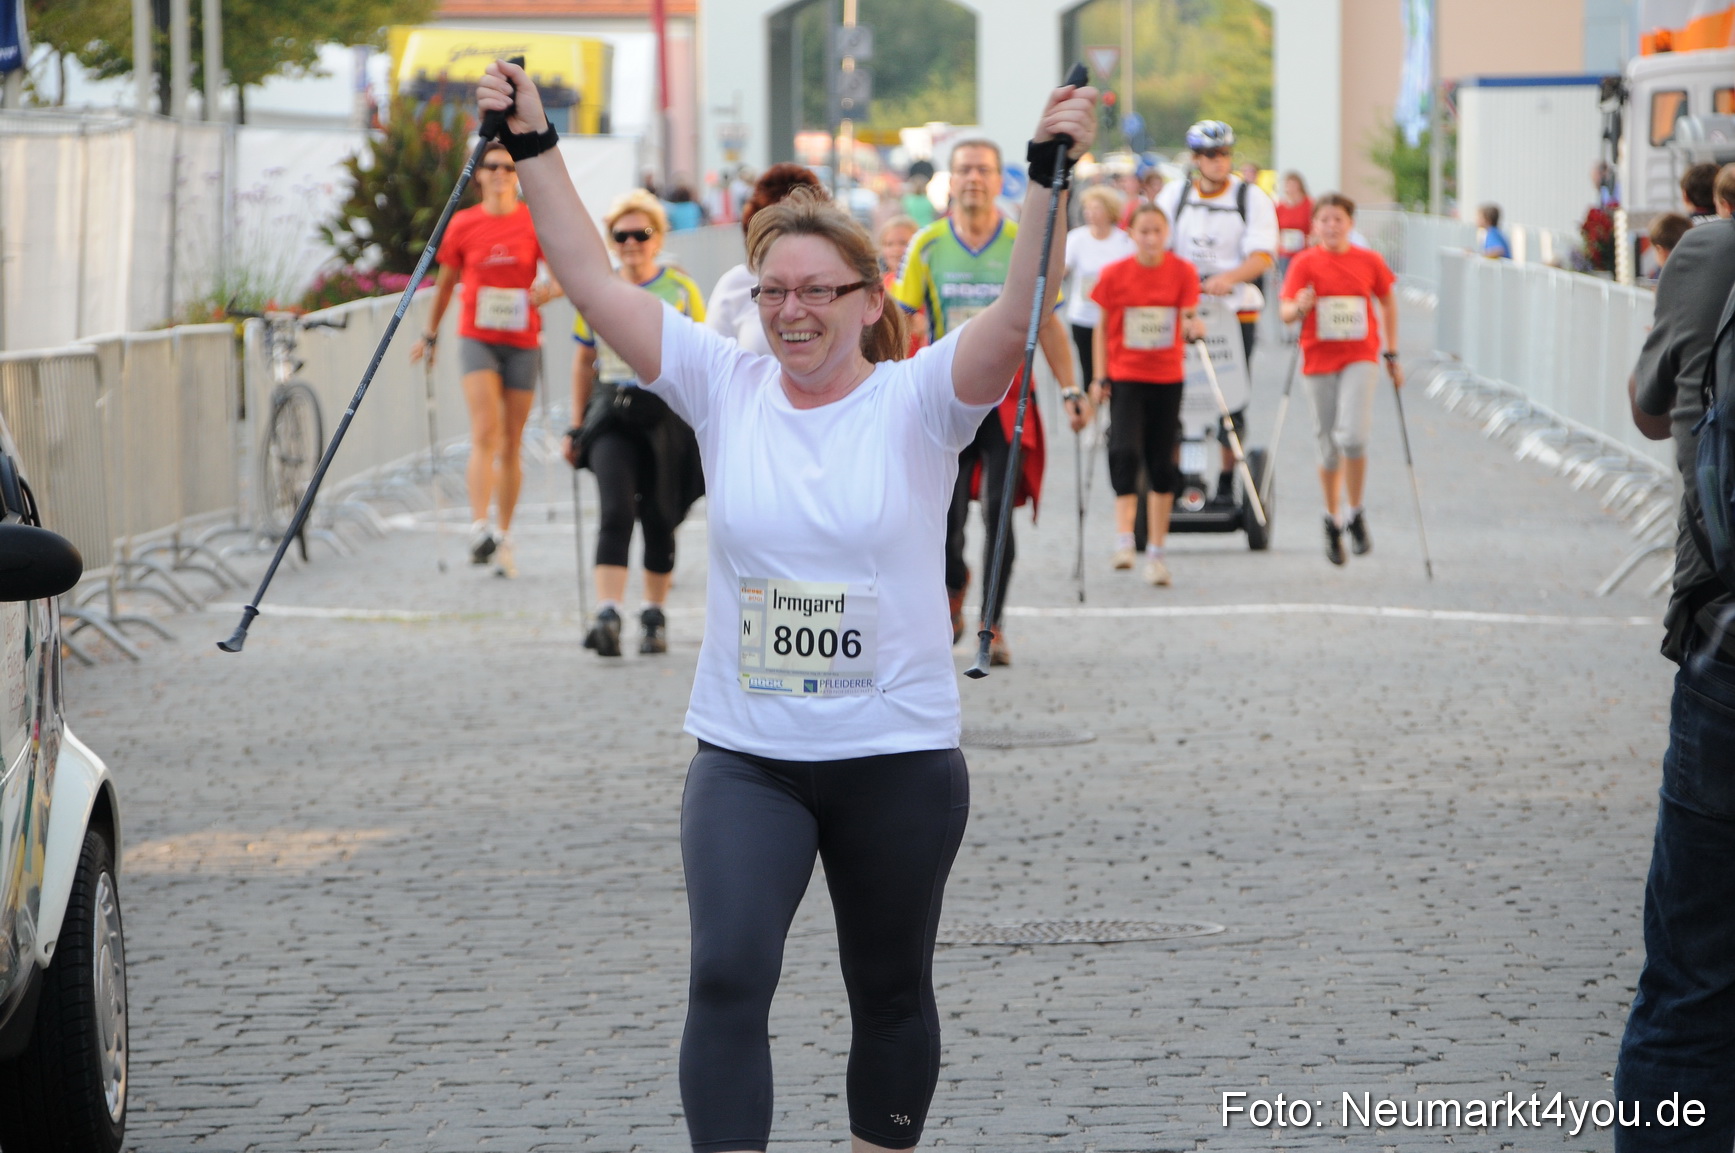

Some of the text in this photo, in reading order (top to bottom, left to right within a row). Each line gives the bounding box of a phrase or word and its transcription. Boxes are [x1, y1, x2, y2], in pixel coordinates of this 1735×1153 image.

[773, 588, 845, 617] Irmgard
[743, 619, 751, 636] N
[773, 625, 862, 659] 8006
[819, 678, 874, 689] PFLEIDERER
